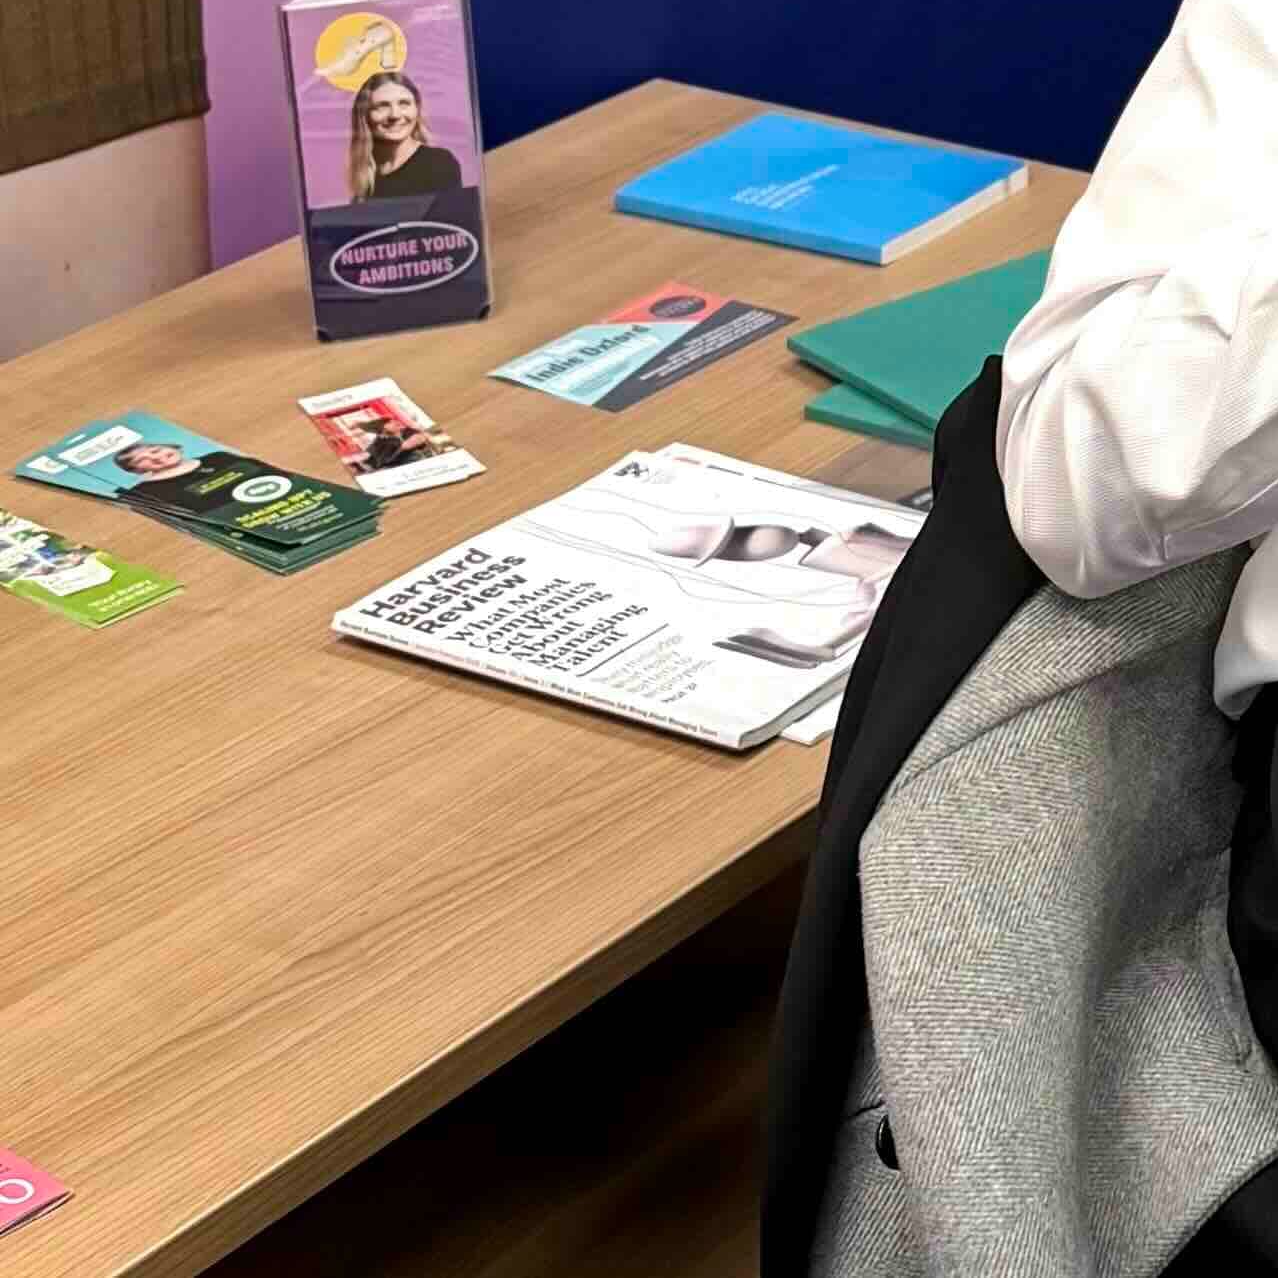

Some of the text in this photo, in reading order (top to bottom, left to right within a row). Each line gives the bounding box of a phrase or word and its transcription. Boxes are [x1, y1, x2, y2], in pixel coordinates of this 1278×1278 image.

[341, 231, 467, 265] NURTURE YOUR
[359, 258, 454, 285] AMBITIONS
[360, 547, 492, 619] Harvard
[386, 555, 526, 627] Business
[413, 573, 527, 635] Review
[448, 577, 571, 642] What Most
[469, 581, 596, 649] Companies
[489, 592, 613, 655] Get Wrong
[511, 620, 584, 661] About
[529, 604, 648, 668] Managing
[545, 629, 628, 672] Talent
